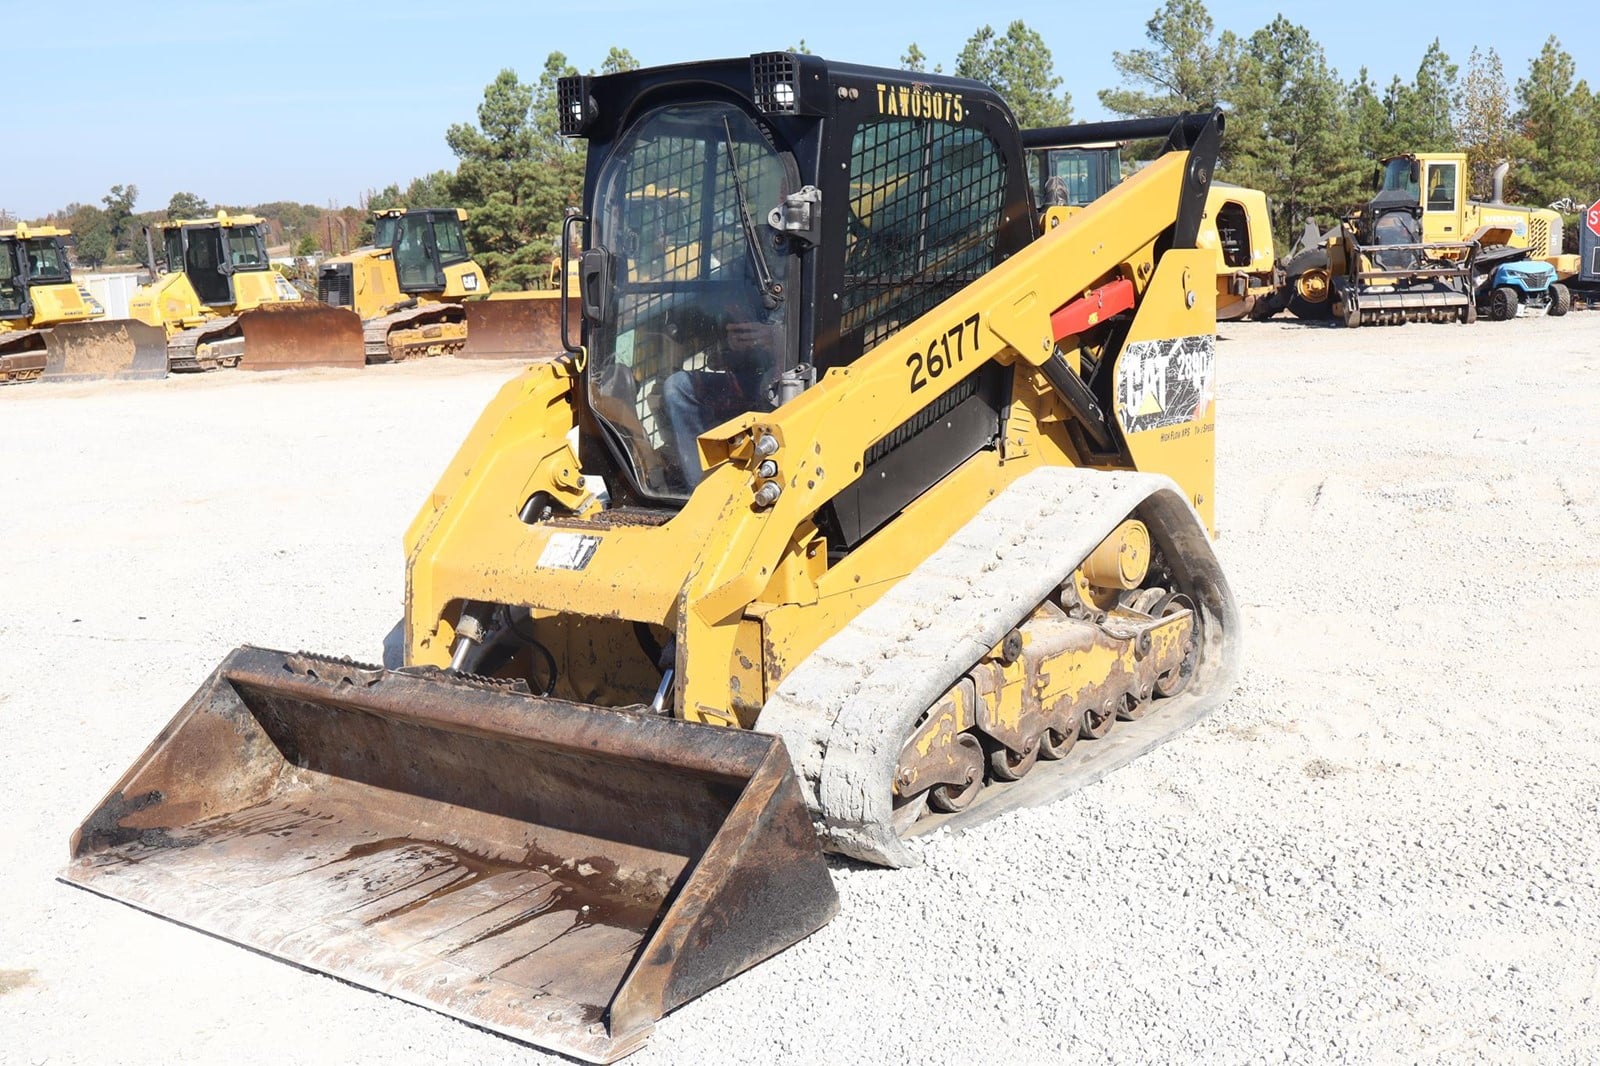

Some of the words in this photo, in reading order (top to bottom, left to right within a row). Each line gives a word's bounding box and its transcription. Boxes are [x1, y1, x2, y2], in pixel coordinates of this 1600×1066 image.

[876, 83, 963, 122] TAW09075
[1589, 210, 1600, 225] S
[906, 312, 980, 393] 26177
[1125, 353, 1169, 417] CAT
